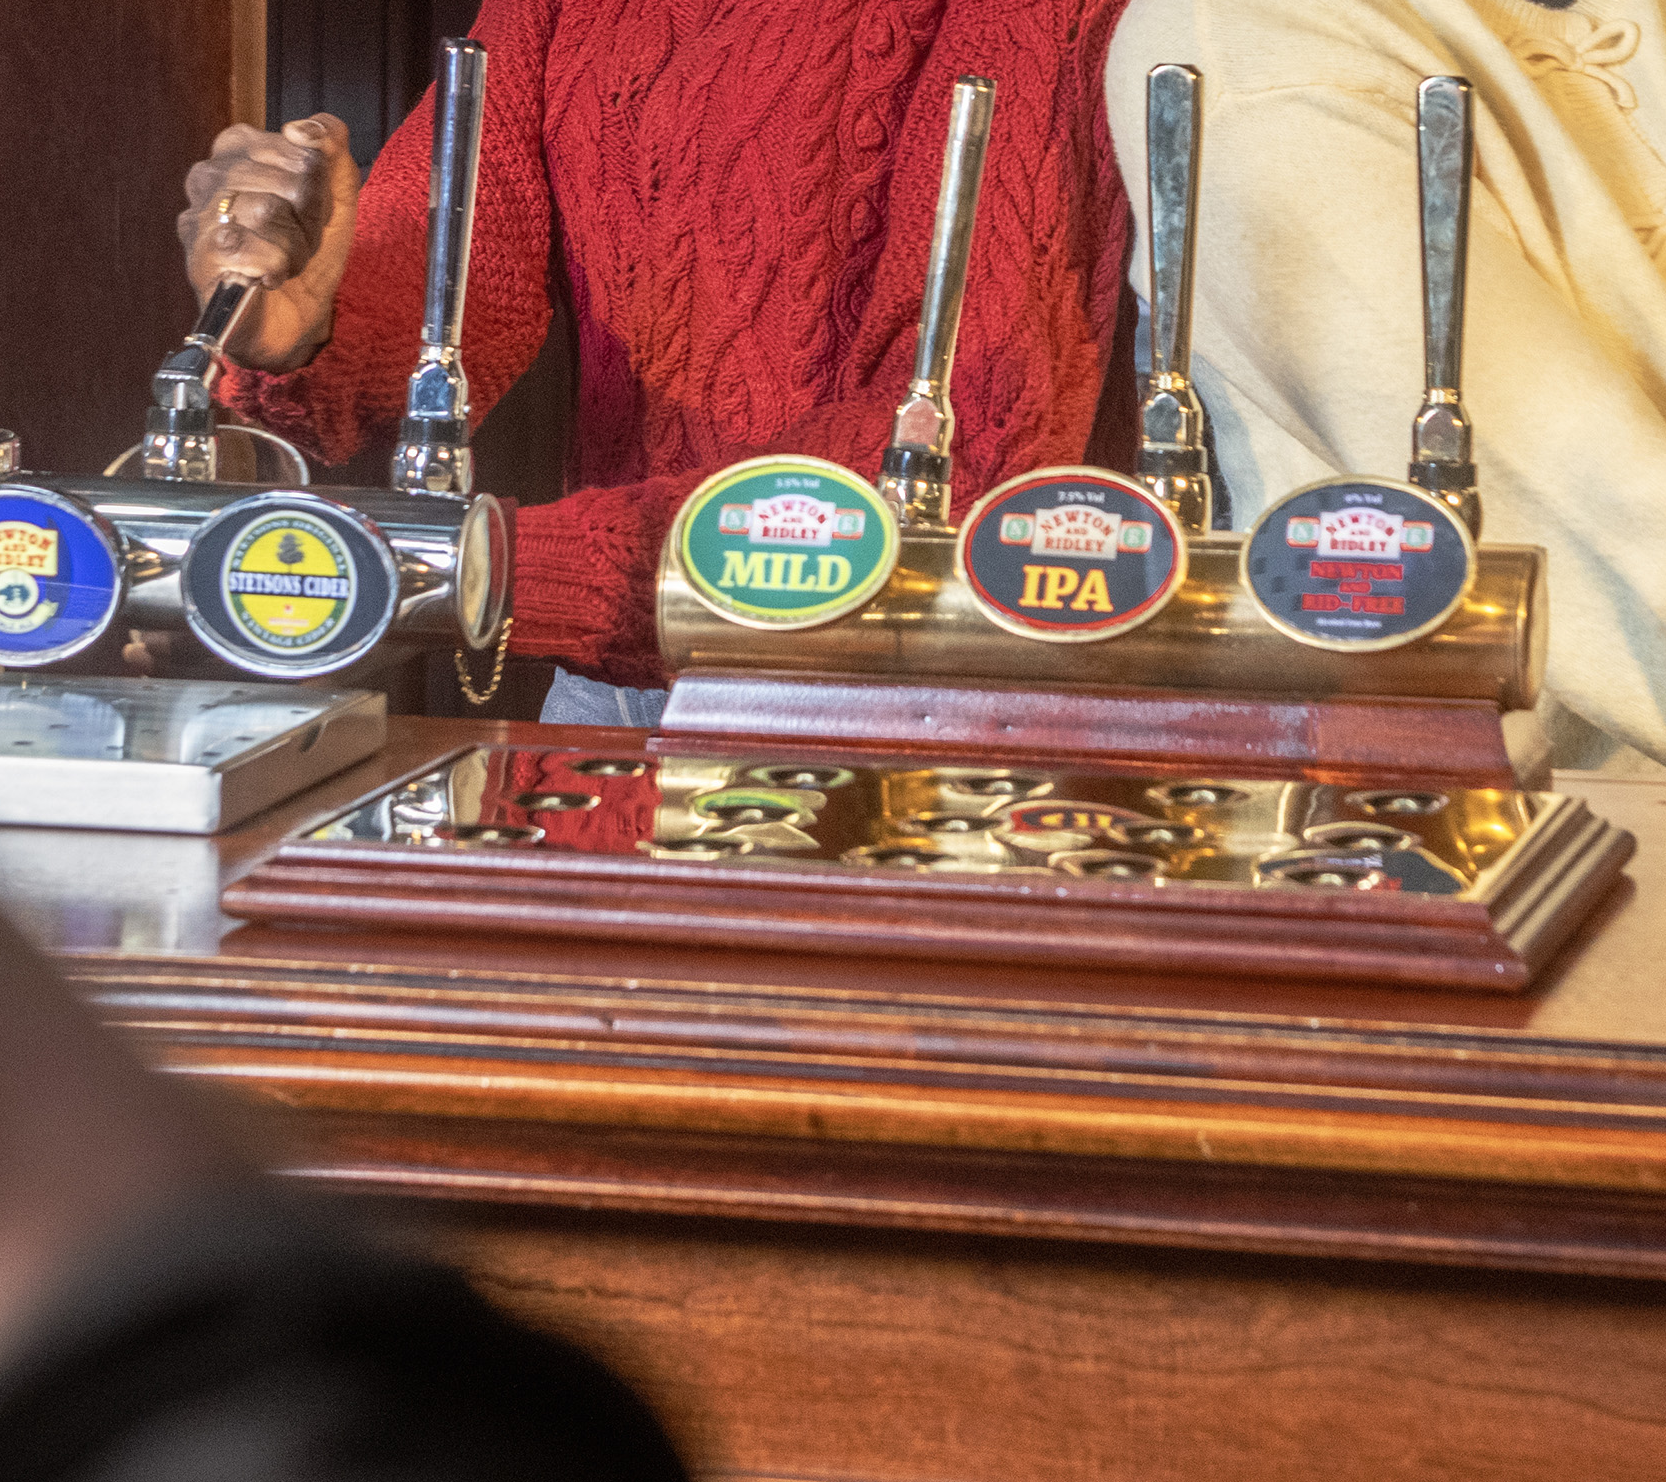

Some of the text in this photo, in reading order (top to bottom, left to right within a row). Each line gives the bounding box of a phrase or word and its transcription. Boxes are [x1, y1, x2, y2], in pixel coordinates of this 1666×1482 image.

[758, 499, 827, 525] NEWTON
[782, 517, 804, 525] AND
[1040, 510, 1115, 538] NEWTON
[761, 526, 821, 540] RIDLEY
[1065, 527, 1088, 536] AND
[1324, 514, 1396, 538] NEWTON
[1044, 537, 1107, 553] RIDLEY
[1330, 538, 1388, 552] RIDLEY
[717, 550, 853, 593] MILD
[228, 570, 349, 600] STETSONS CIDER
[1017, 564, 1115, 613] IPA
